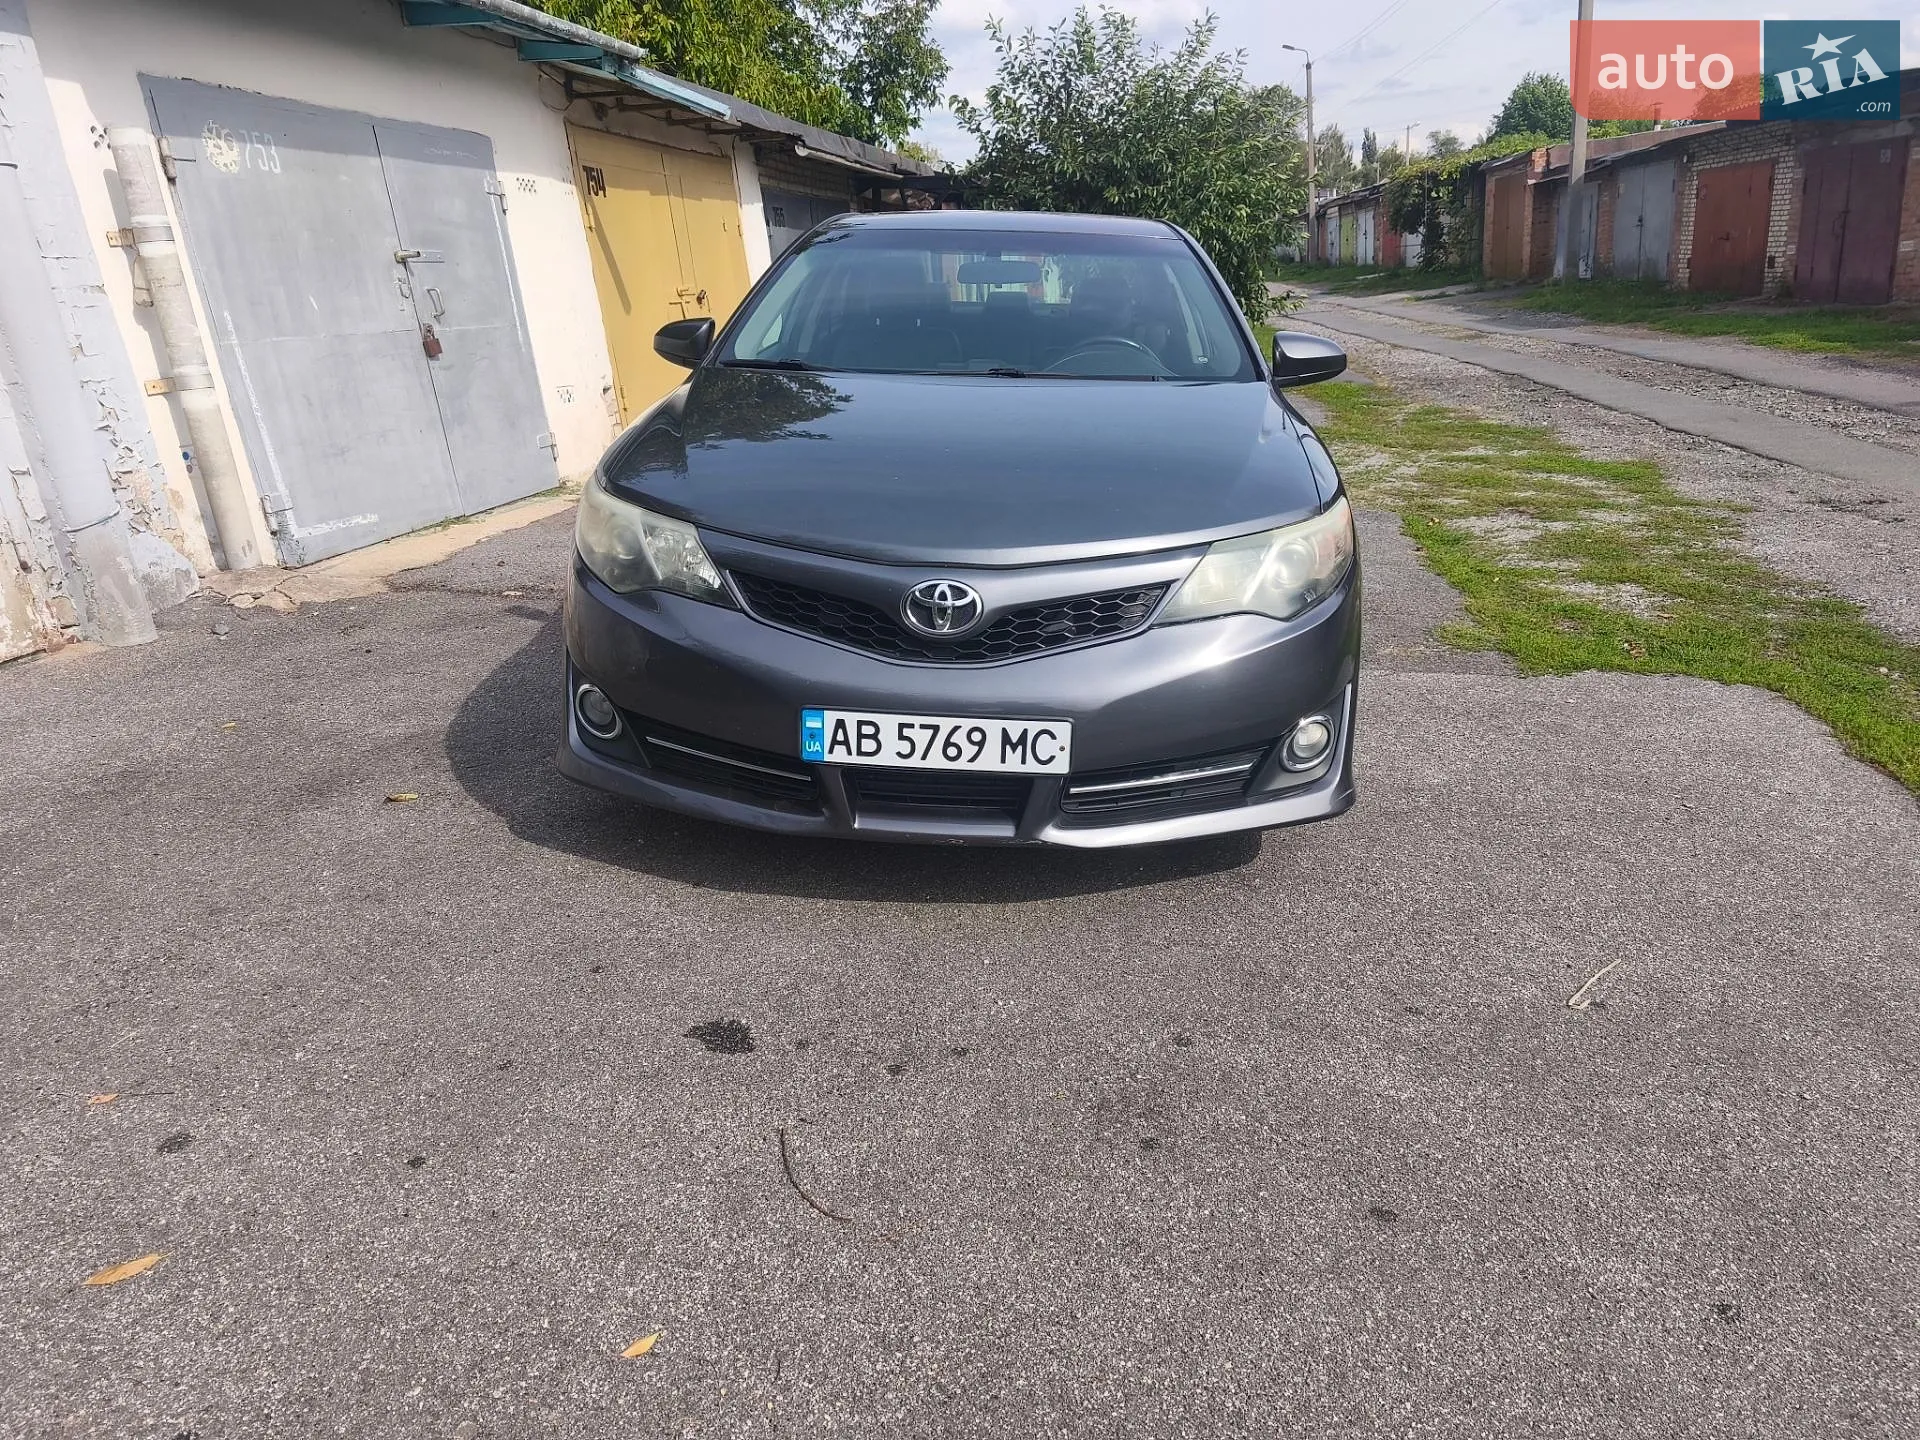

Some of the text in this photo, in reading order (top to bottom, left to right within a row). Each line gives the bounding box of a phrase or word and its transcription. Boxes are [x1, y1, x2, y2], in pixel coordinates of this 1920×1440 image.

[238, 129, 281, 174] 753
[582, 165, 607, 198] 754
[805, 742, 822, 753] UA
[828, 718, 1057, 766] AB 5769 MC
